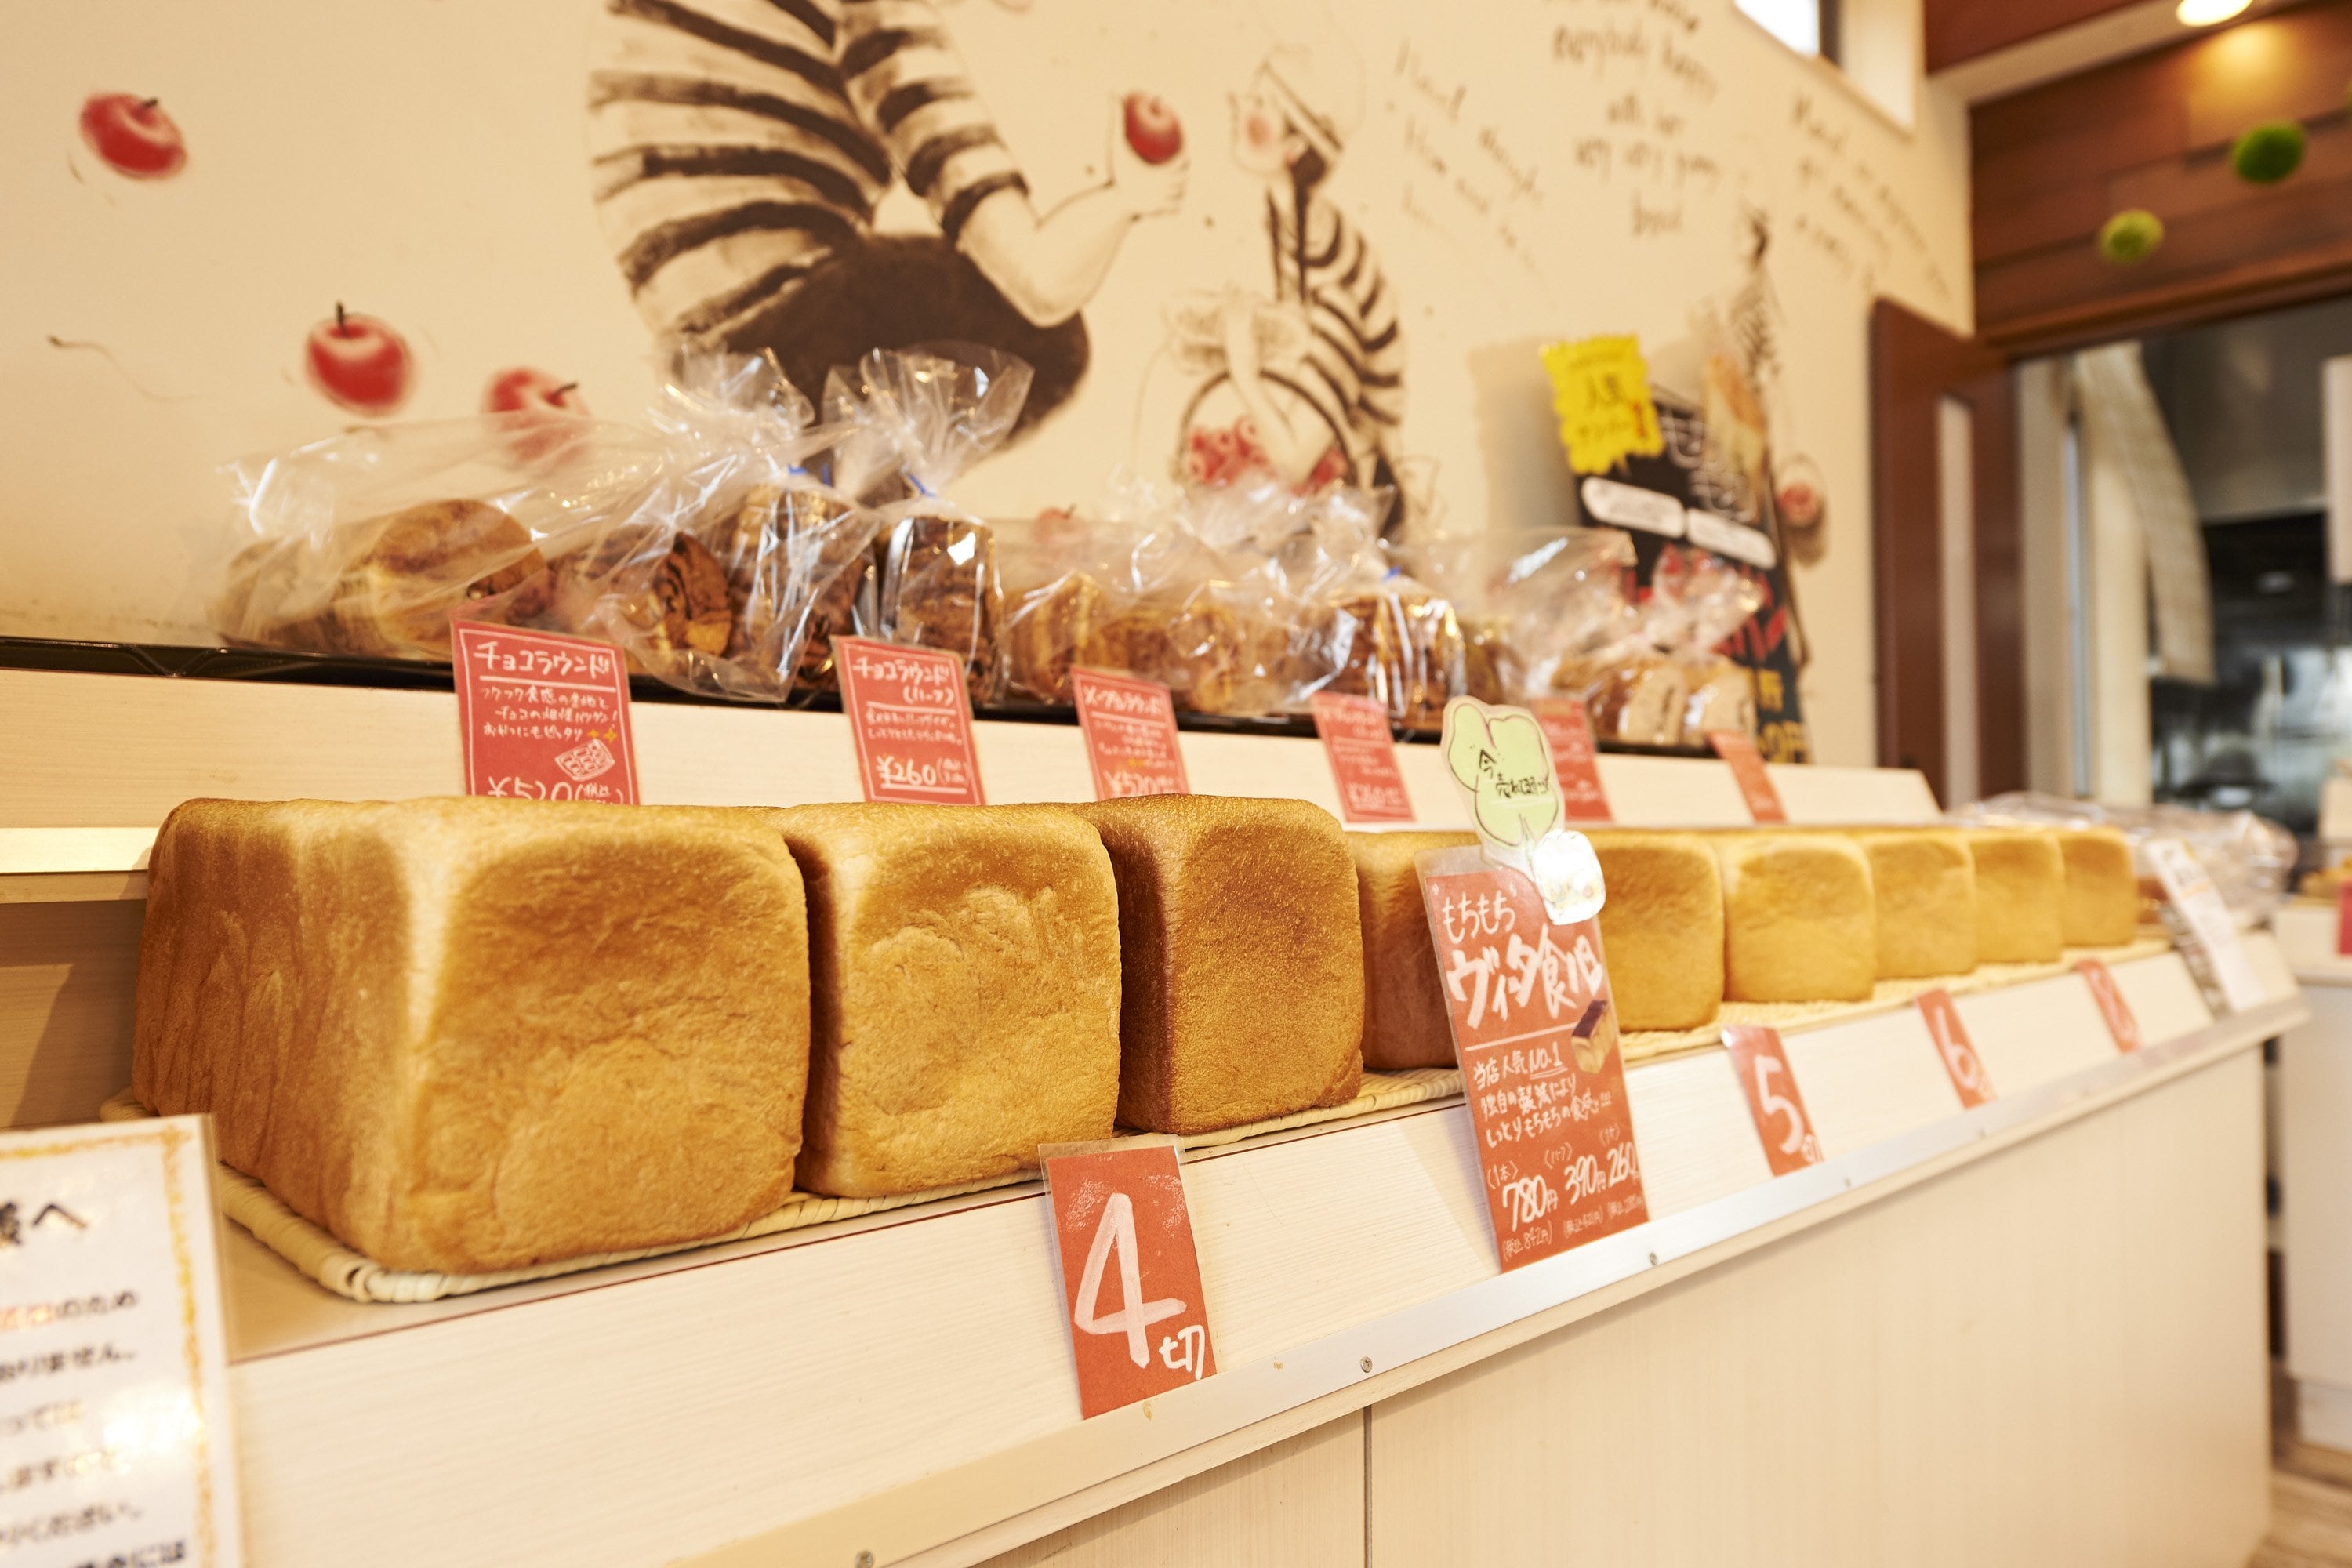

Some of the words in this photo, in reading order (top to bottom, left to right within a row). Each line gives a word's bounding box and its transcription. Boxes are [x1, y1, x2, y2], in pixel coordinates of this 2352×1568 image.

[474, 641, 611, 679] チョコラウンド
[1442, 891, 1516, 946] もちもち
[1502, 1174, 1559, 1232] 780円
[1563, 1154, 1607, 1205] 390円
